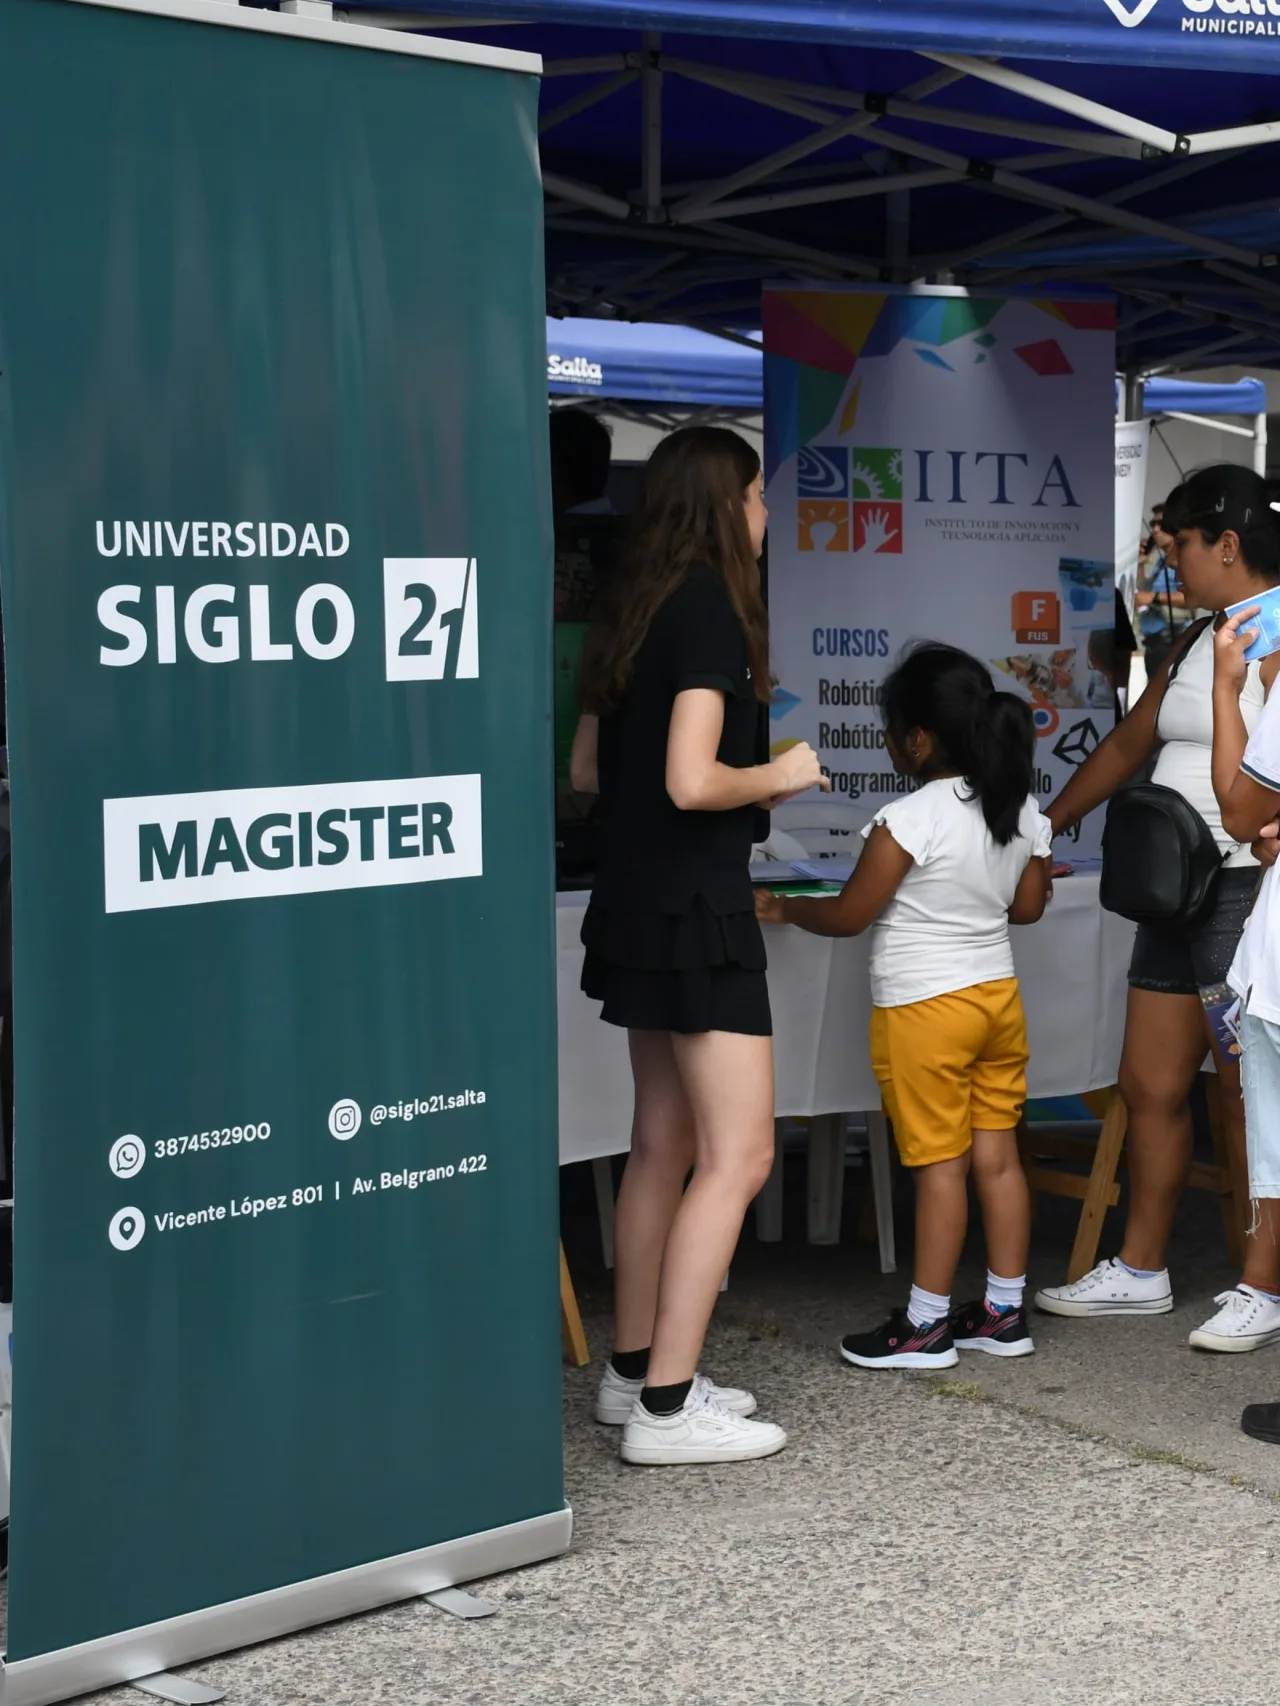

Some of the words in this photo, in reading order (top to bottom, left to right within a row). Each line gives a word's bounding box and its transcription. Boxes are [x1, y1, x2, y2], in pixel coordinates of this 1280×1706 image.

[547, 354, 603, 379] Salta
[914, 449, 1083, 507] IITA
[96, 520, 350, 558] UNIVERSIDAD
[925, 518, 985, 529] INSTITUTO
[96, 582, 356, 668] SIGLO
[1031, 599, 1047, 621] F
[812, 627, 890, 658] CURSOS
[1027, 631, 1049, 641] FUS
[818, 678, 885, 706] Robótic
[818, 721, 886, 750] Robótic
[138, 801, 456, 883] MAGISTER
[370, 1089, 487, 1126] @siglo21.salta
[154, 1122, 271, 1159] 3874532900
[154, 1201, 227, 1232] Vicente
[231, 1192, 287, 1217] López
[291, 1184, 324, 1206] 801
[352, 1177, 377, 1196] Av.
[380, 1162, 455, 1190] Belgrano
[458, 1154, 488, 1175] 422
